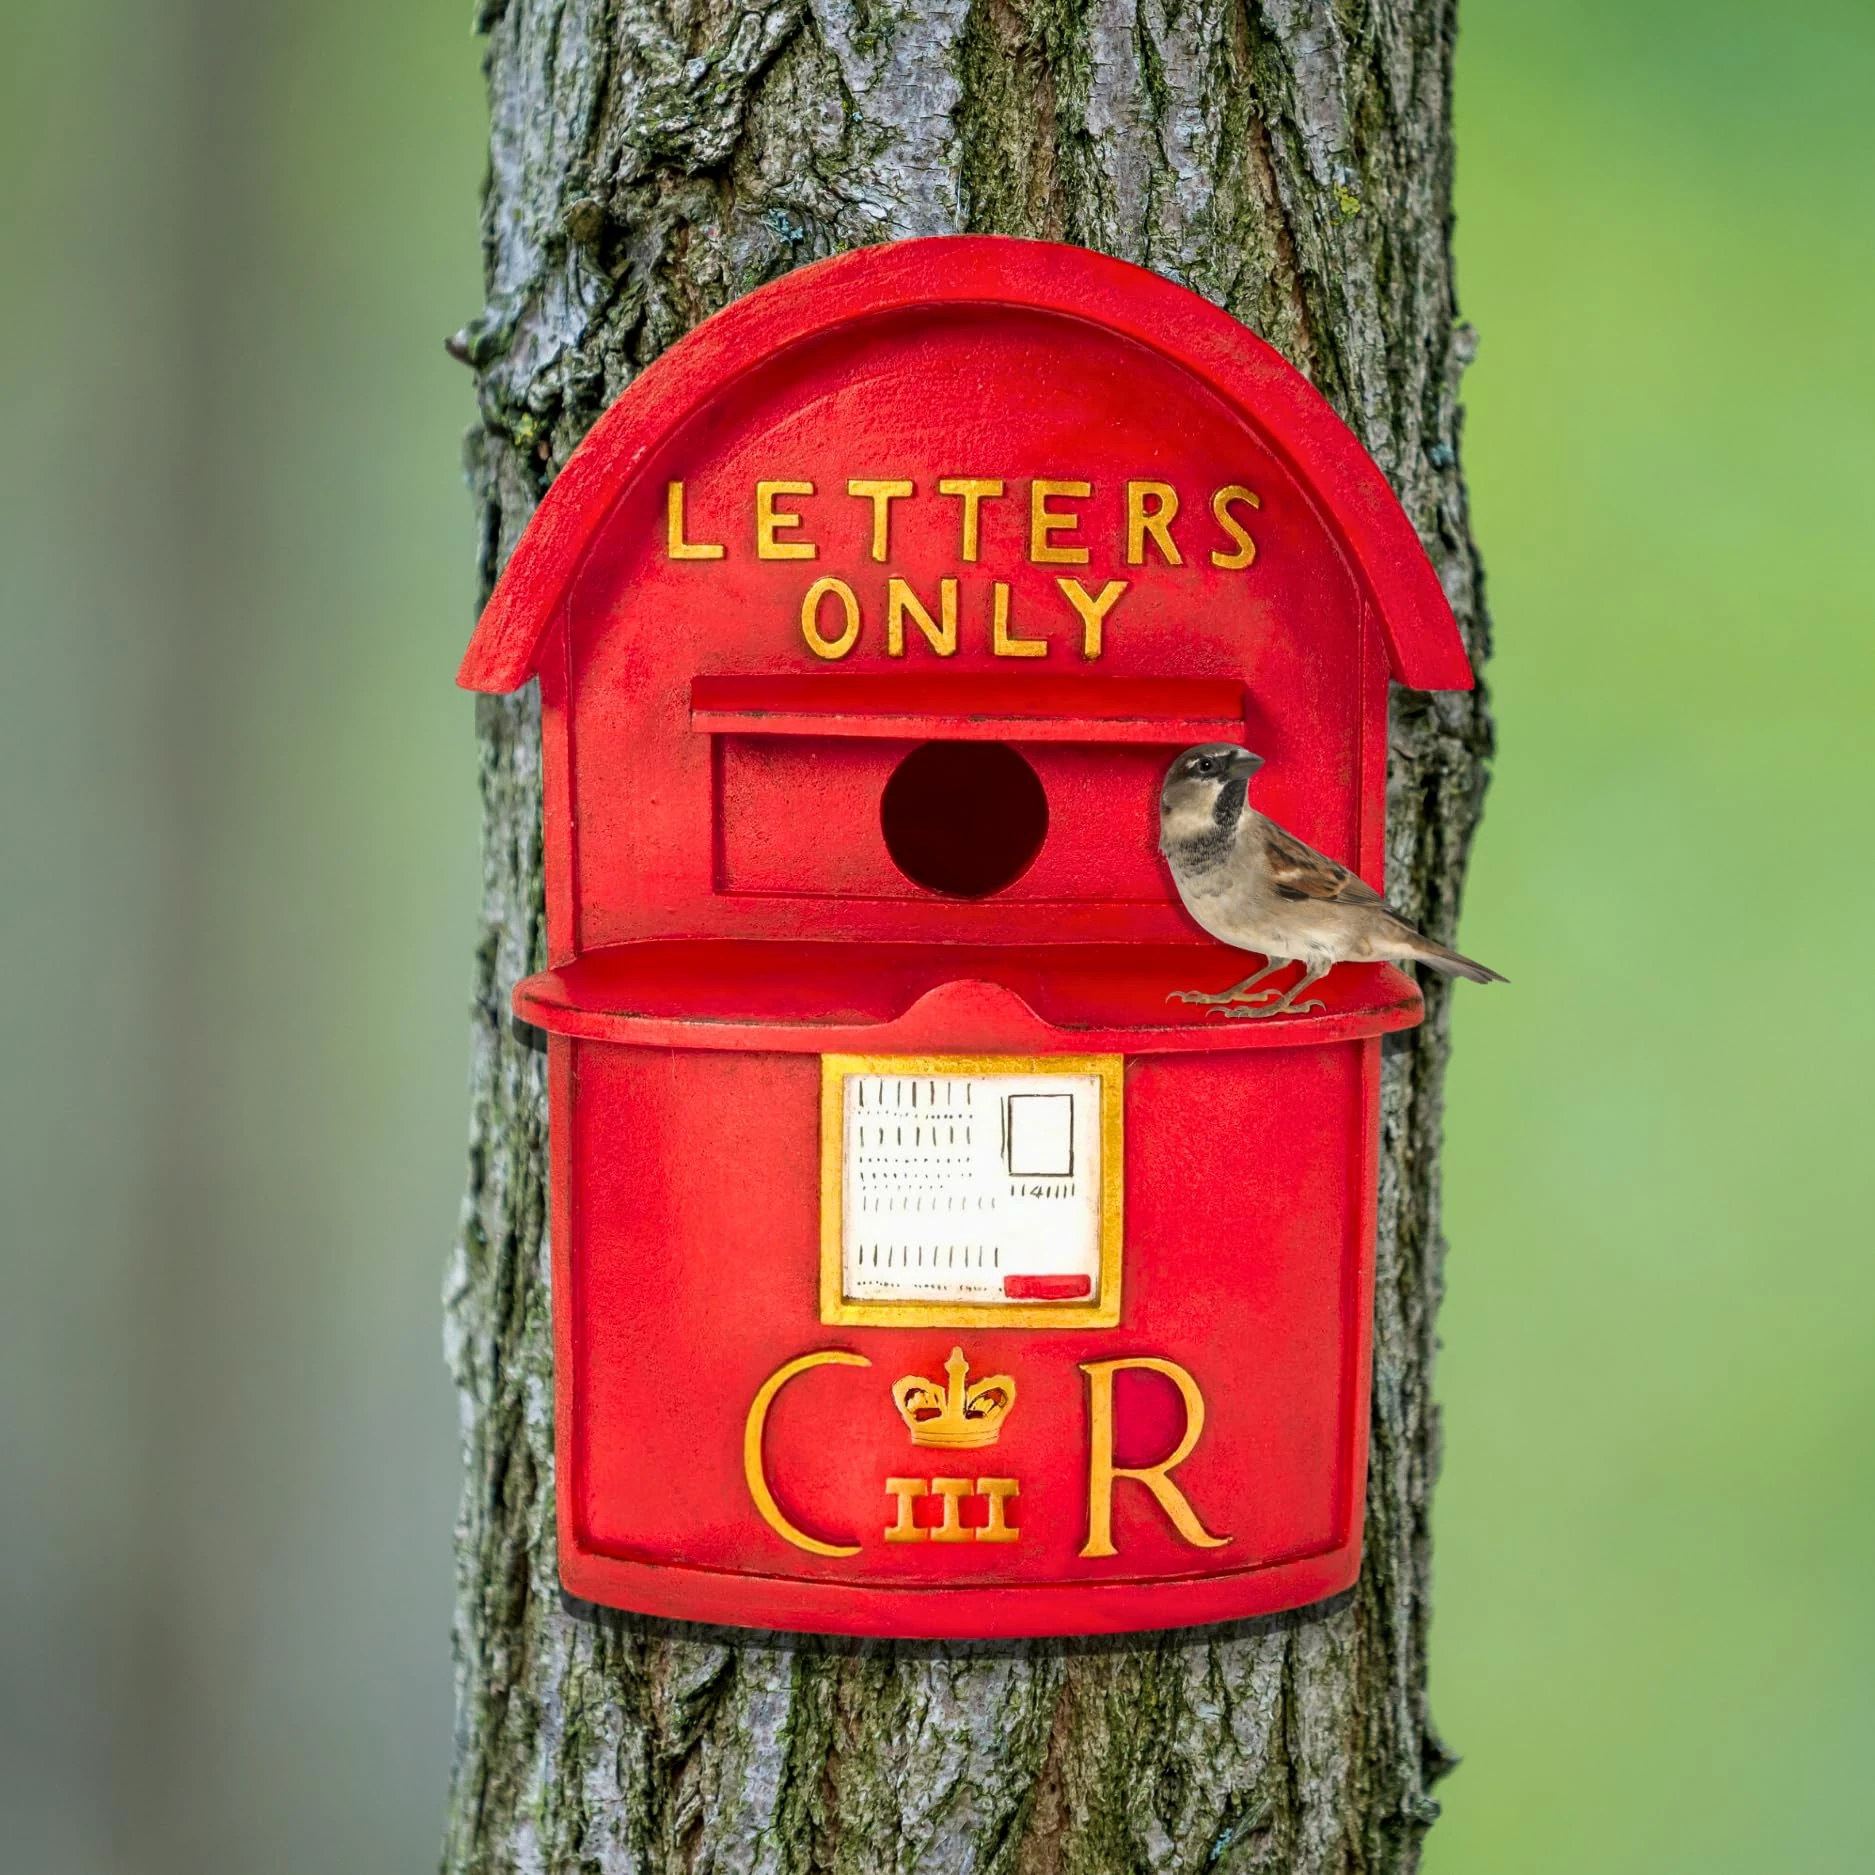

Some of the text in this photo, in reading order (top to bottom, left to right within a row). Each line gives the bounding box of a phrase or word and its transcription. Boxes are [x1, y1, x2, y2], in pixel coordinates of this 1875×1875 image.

[667, 478, 1260, 570] LETTERS
[800, 574, 1131, 660] ONLY
[743, 1350, 1234, 1558] C III R
